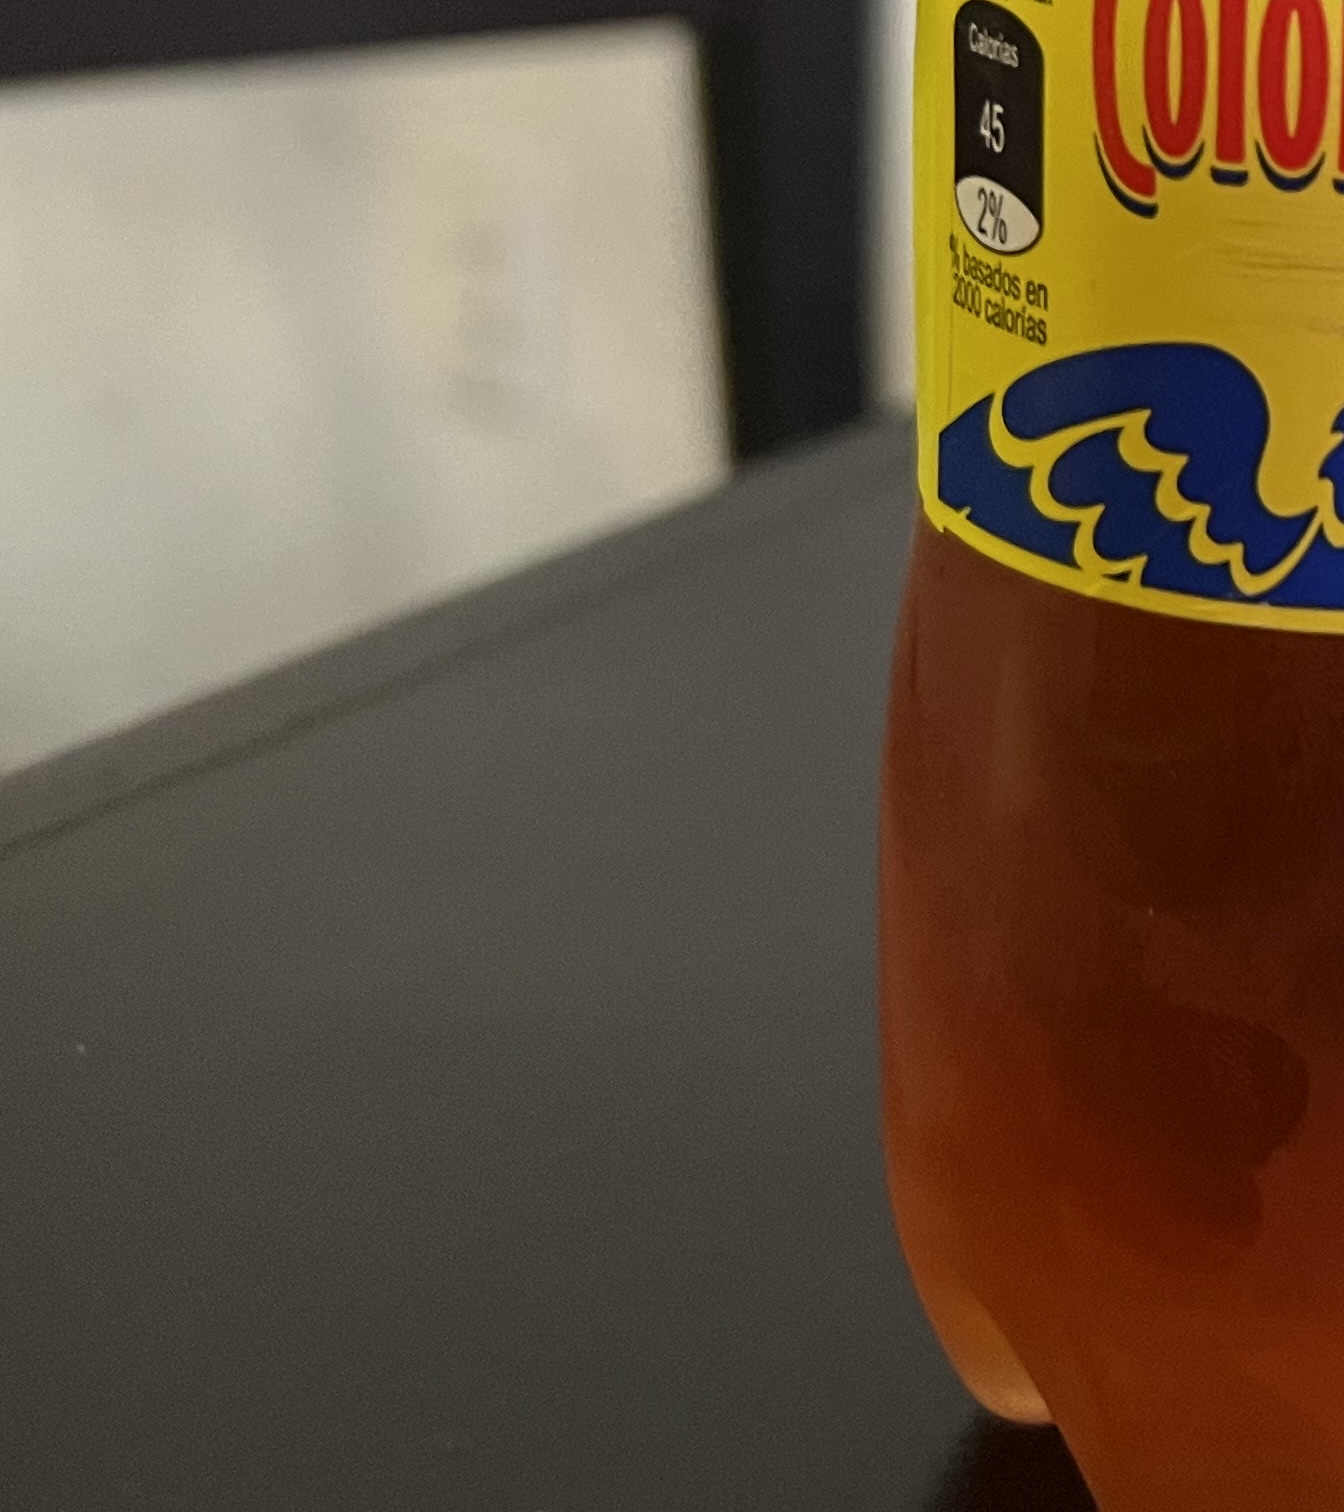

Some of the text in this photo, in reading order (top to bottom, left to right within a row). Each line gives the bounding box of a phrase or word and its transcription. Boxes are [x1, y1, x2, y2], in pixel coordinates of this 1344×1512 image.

[979, 98, 1006, 153] 45
[976, 187, 1008, 245] 2%
[1026, 278, 1049, 312] en
